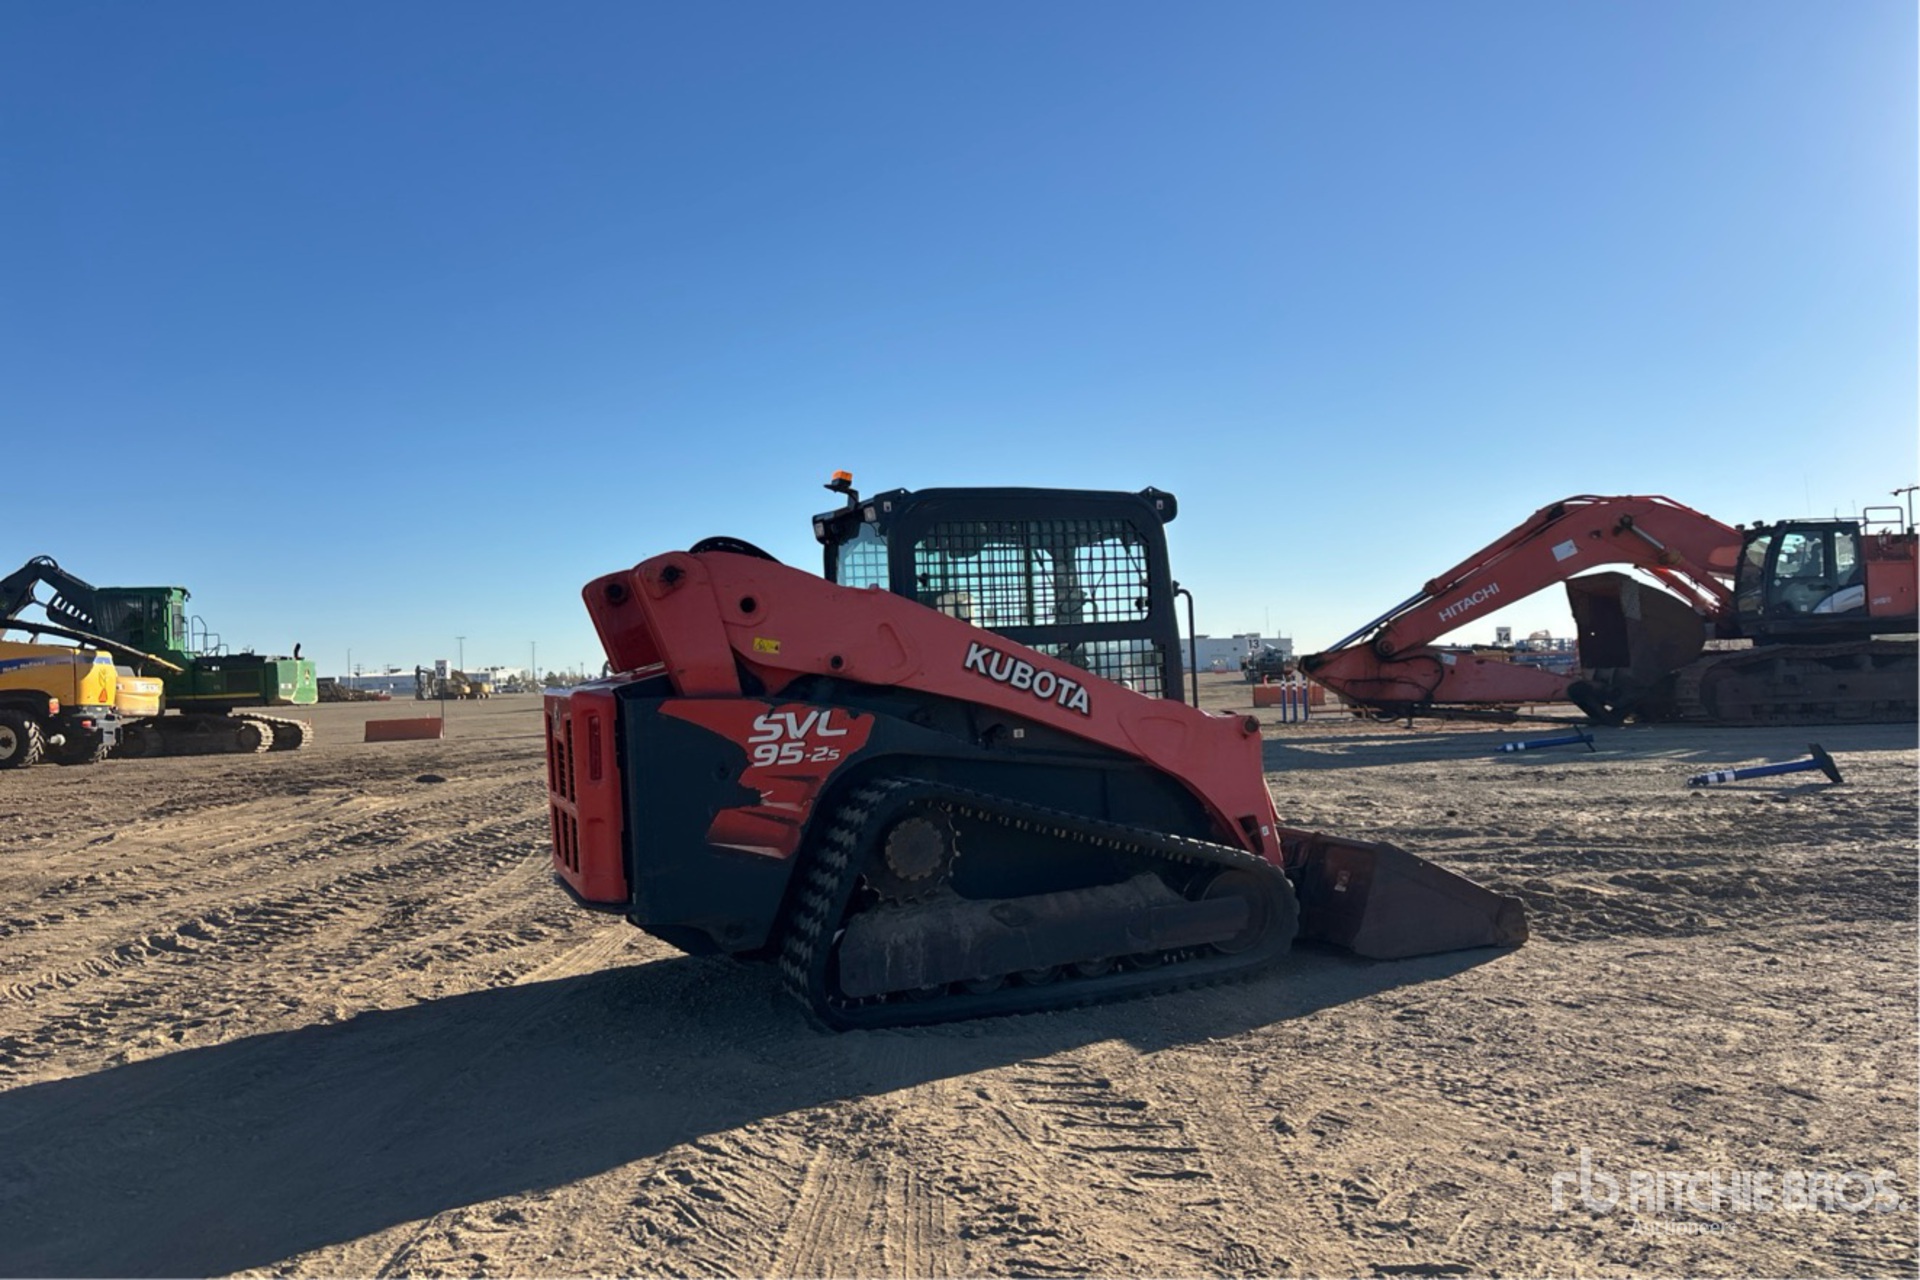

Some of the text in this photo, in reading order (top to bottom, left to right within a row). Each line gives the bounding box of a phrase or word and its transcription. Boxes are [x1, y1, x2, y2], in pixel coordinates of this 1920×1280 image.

[1438, 582, 1500, 622] HITACHI
[1248, 639, 1260, 649] 13
[964, 642, 1090, 715] KUBOTA
[747, 709, 848, 743] SVL
